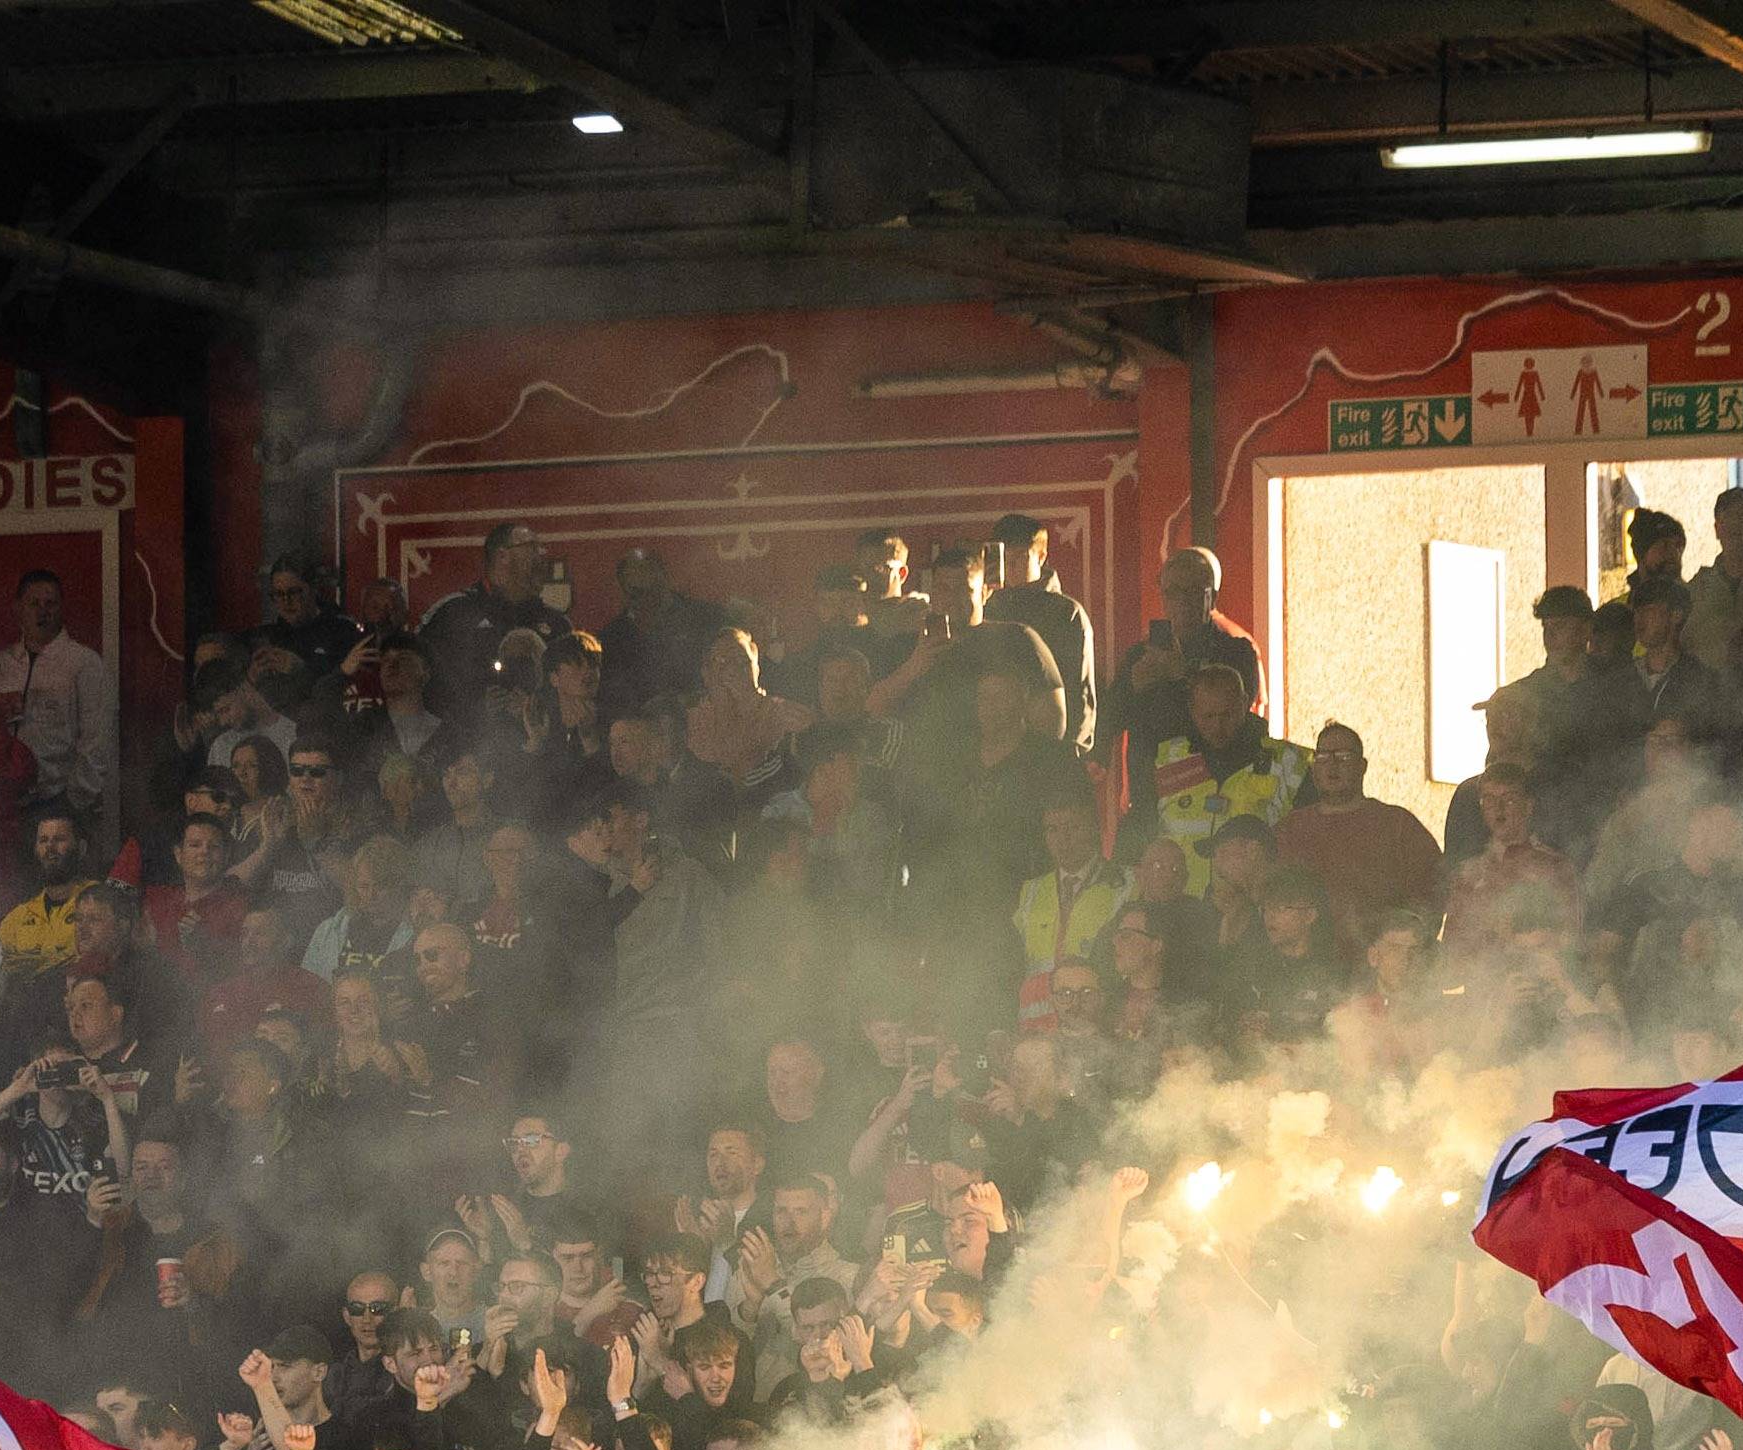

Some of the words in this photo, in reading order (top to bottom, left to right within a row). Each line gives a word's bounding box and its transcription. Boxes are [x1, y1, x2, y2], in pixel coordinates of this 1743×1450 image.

[1652, 391, 1686, 408] Fire
[1338, 406, 1371, 424] Fire
[1652, 414, 1685, 431] exit
[1338, 429, 1371, 447] exit
